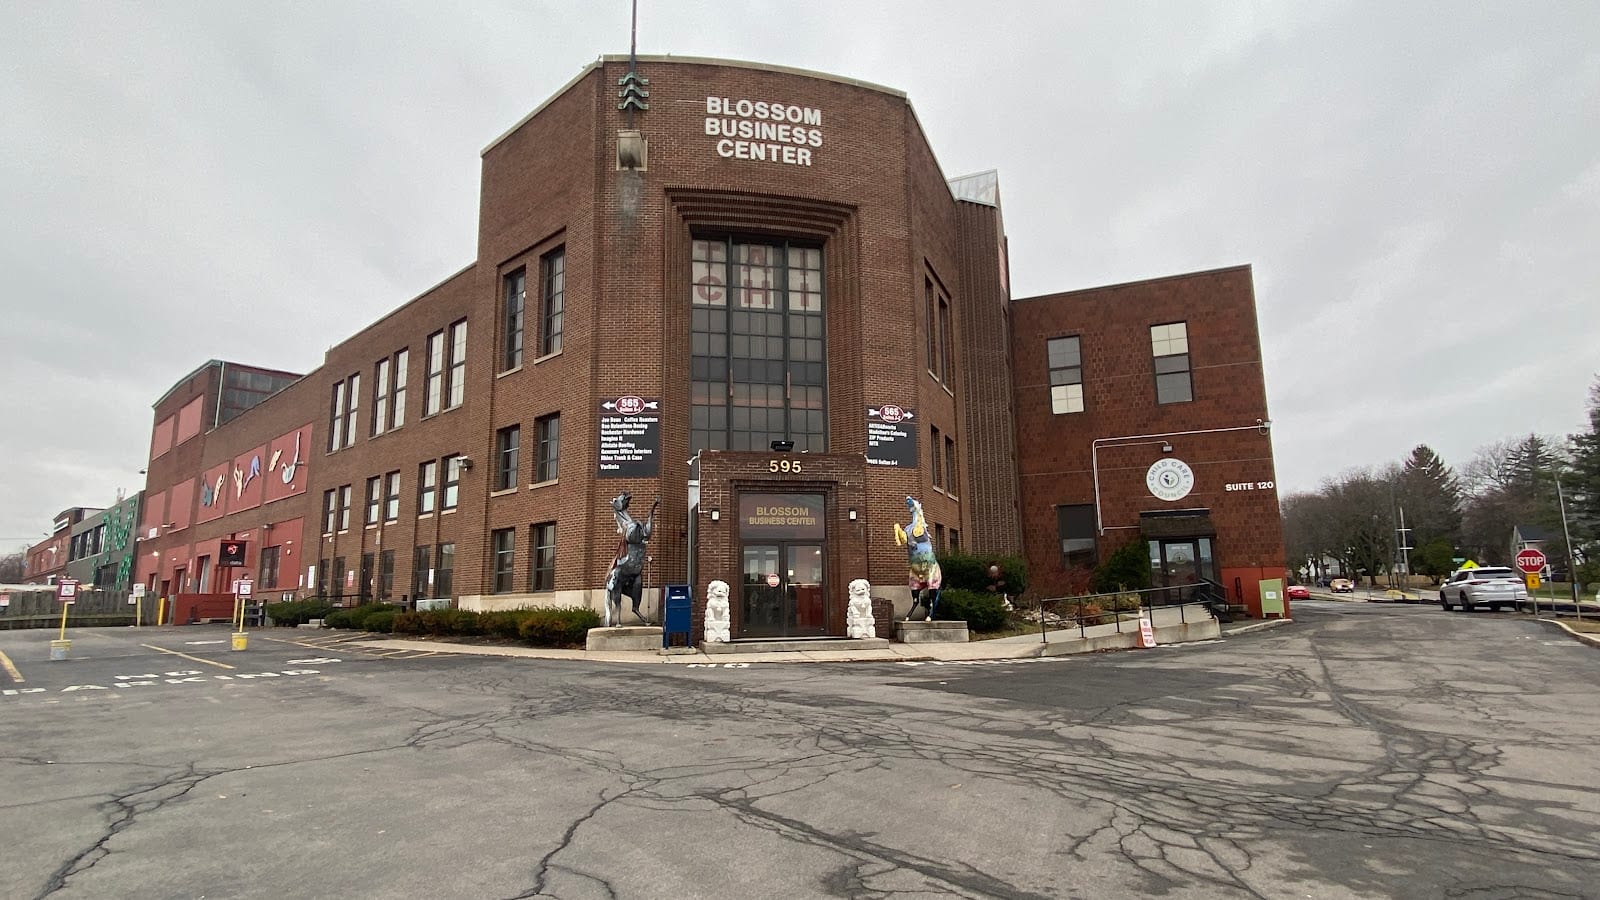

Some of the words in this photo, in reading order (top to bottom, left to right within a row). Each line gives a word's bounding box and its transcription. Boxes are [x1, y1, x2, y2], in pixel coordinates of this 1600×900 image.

[706, 96, 821, 126] BLOSSOM
[705, 117, 823, 147] BUSINESS
[716, 139, 812, 166] CENTER
[697, 275, 810, 307] CHI
[621, 399, 639, 407] 565
[884, 407, 899, 416] 565
[769, 460, 802, 473] 595
[1149, 461, 1168, 481] CHILD
[1171, 461, 1191, 480] CARE
[1152, 484, 1190, 498] COUNCIL
[1225, 482, 1254, 492] SUITE
[1257, 481, 1274, 490] 120
[756, 506, 809, 516] BLOSSOM
[749, 516, 786, 525] BUSINESS
[786, 517, 816, 526] CENTER
[1517, 556, 1544, 566] STOP
[2, 669, 321, 695] PARKING
